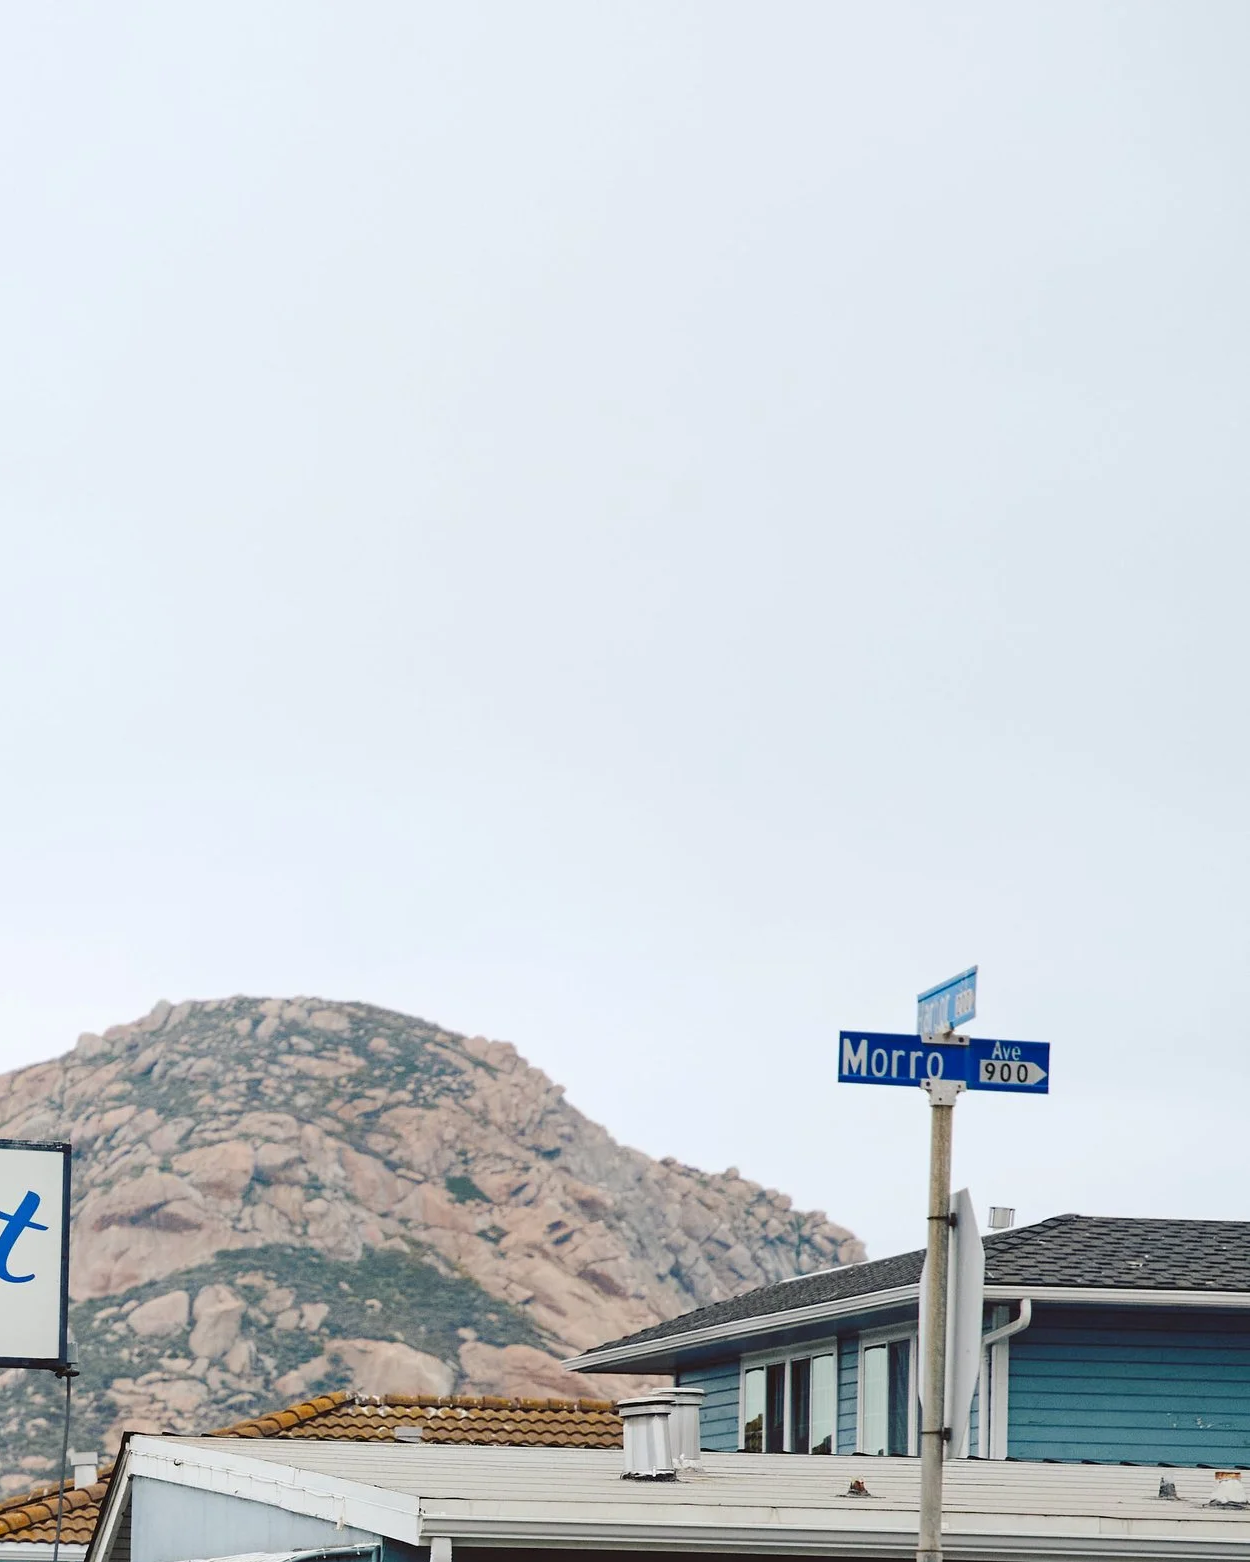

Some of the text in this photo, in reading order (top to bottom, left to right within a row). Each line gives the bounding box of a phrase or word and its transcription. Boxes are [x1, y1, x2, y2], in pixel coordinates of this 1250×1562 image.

[842, 1038, 1022, 1079] Morro Ave
[984, 1062, 1028, 1083] 900
